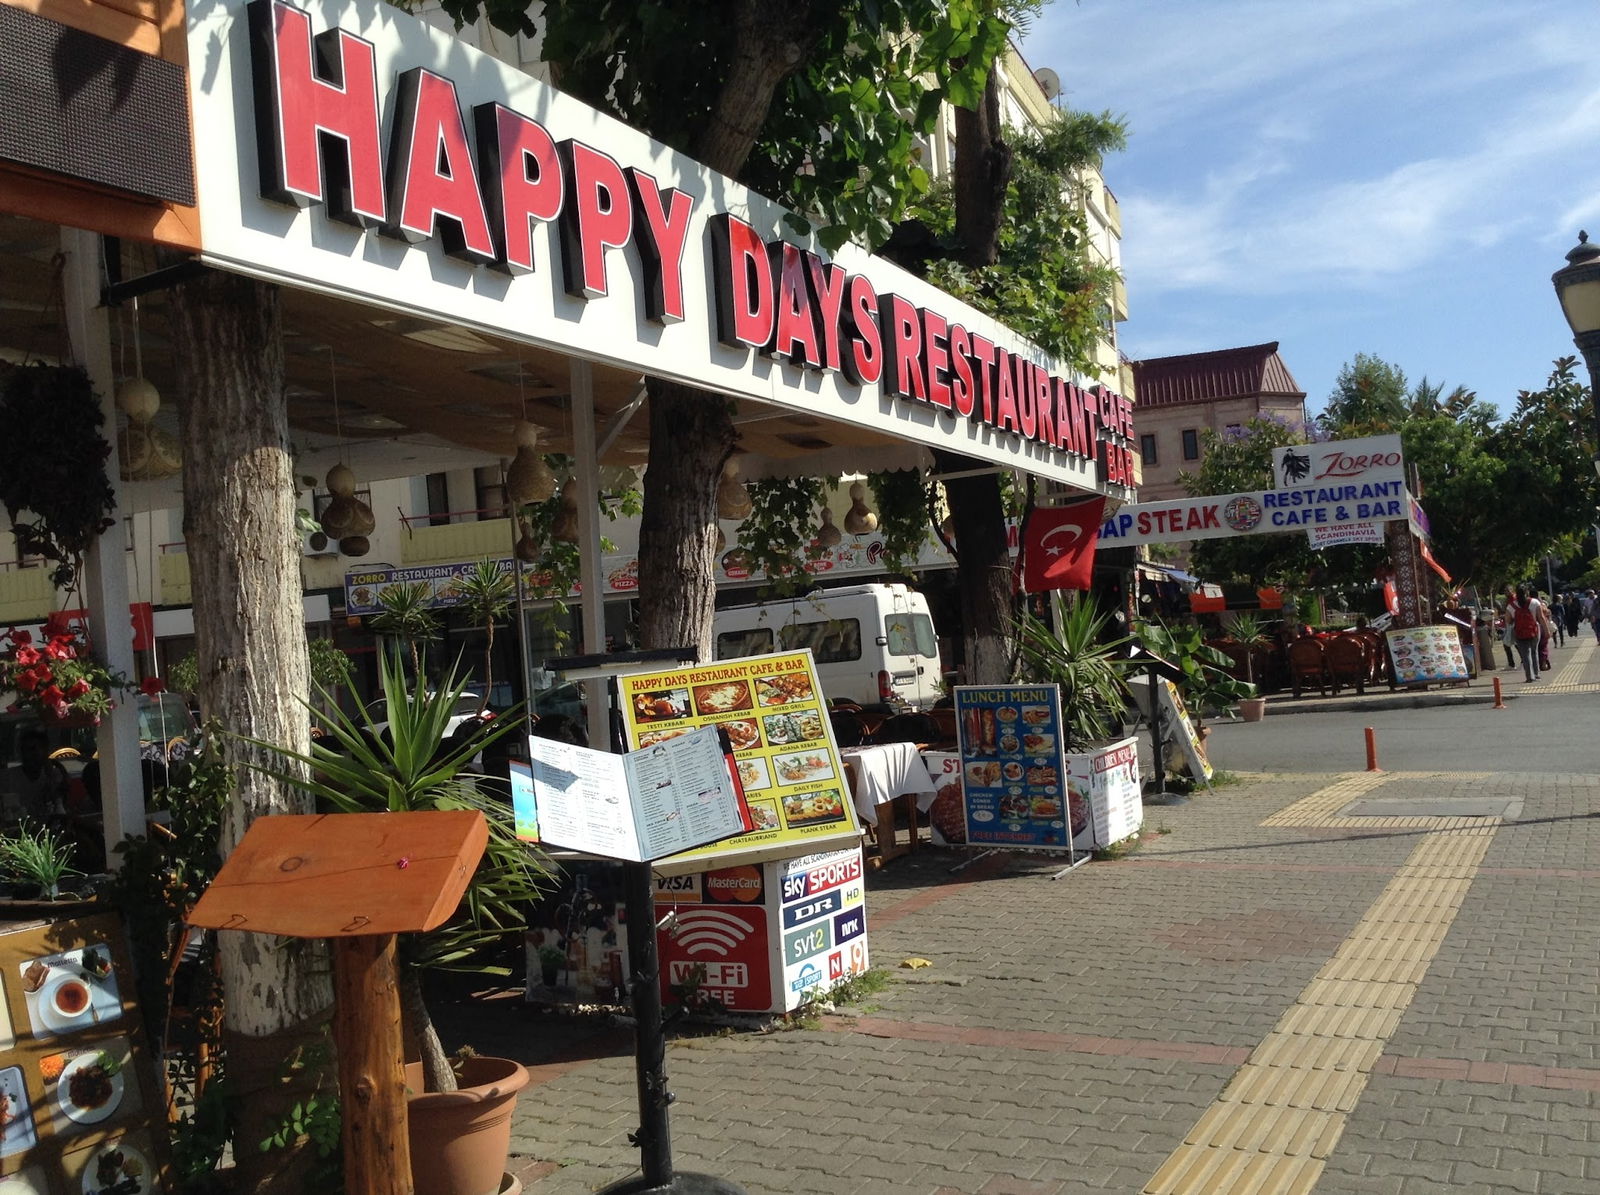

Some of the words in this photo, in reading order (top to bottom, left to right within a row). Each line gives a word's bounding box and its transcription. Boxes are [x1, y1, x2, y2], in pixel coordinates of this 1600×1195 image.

[250, 0, 694, 324] HAPPY
[712, 213, 884, 386] DAYS
[882, 293, 1098, 461] RESTAURANT
[1095, 384, 1134, 440] CAFE
[1101, 441, 1136, 490] BAR
[1314, 451, 1401, 480] ZORRO
[1263, 480, 1402, 509] RESTAURANT
[1098, 514, 1133, 540] AP
[1137, 504, 1221, 536] STEAK
[1272, 507, 1328, 526] CAFE
[1335, 505, 1349, 521] &
[1357, 500, 1401, 519] BAR
[1315, 529, 1376, 541] SCANDINAVIA
[352, 573, 386, 585] ZORRO
[391, 566, 453, 582] RESTAURANT
[614, 580, 634, 588] PIZZA
[632, 677, 662, 691] HAPPY
[664, 673, 688, 687] DAYS
[690, 666, 748, 684] RESTAURANT
[750, 663, 774, 675] CAFE
[775, 662, 784, 672] &
[785, 658, 804, 671] BAR
[962, 690, 1006, 704] LUNCH
[1010, 690, 1048, 703] MENU
[793, 784, 810, 793] DAILY
[810, 782, 823, 791] FISH
[819, 823, 837, 832] STEAK
[729, 833, 778, 846] CHATEAUBRIAND
[656, 875, 694, 890] VISA
[707, 876, 761, 889] MasterCard
[784, 873, 806, 899] sky
[809, 858, 860, 894] SPORTS
[794, 896, 833, 920] DR
[846, 887, 860, 900] HD
[673, 964, 744, 986] Wi-Fi
[805, 970, 821, 985] SPORT
[695, 988, 736, 1006] REE
